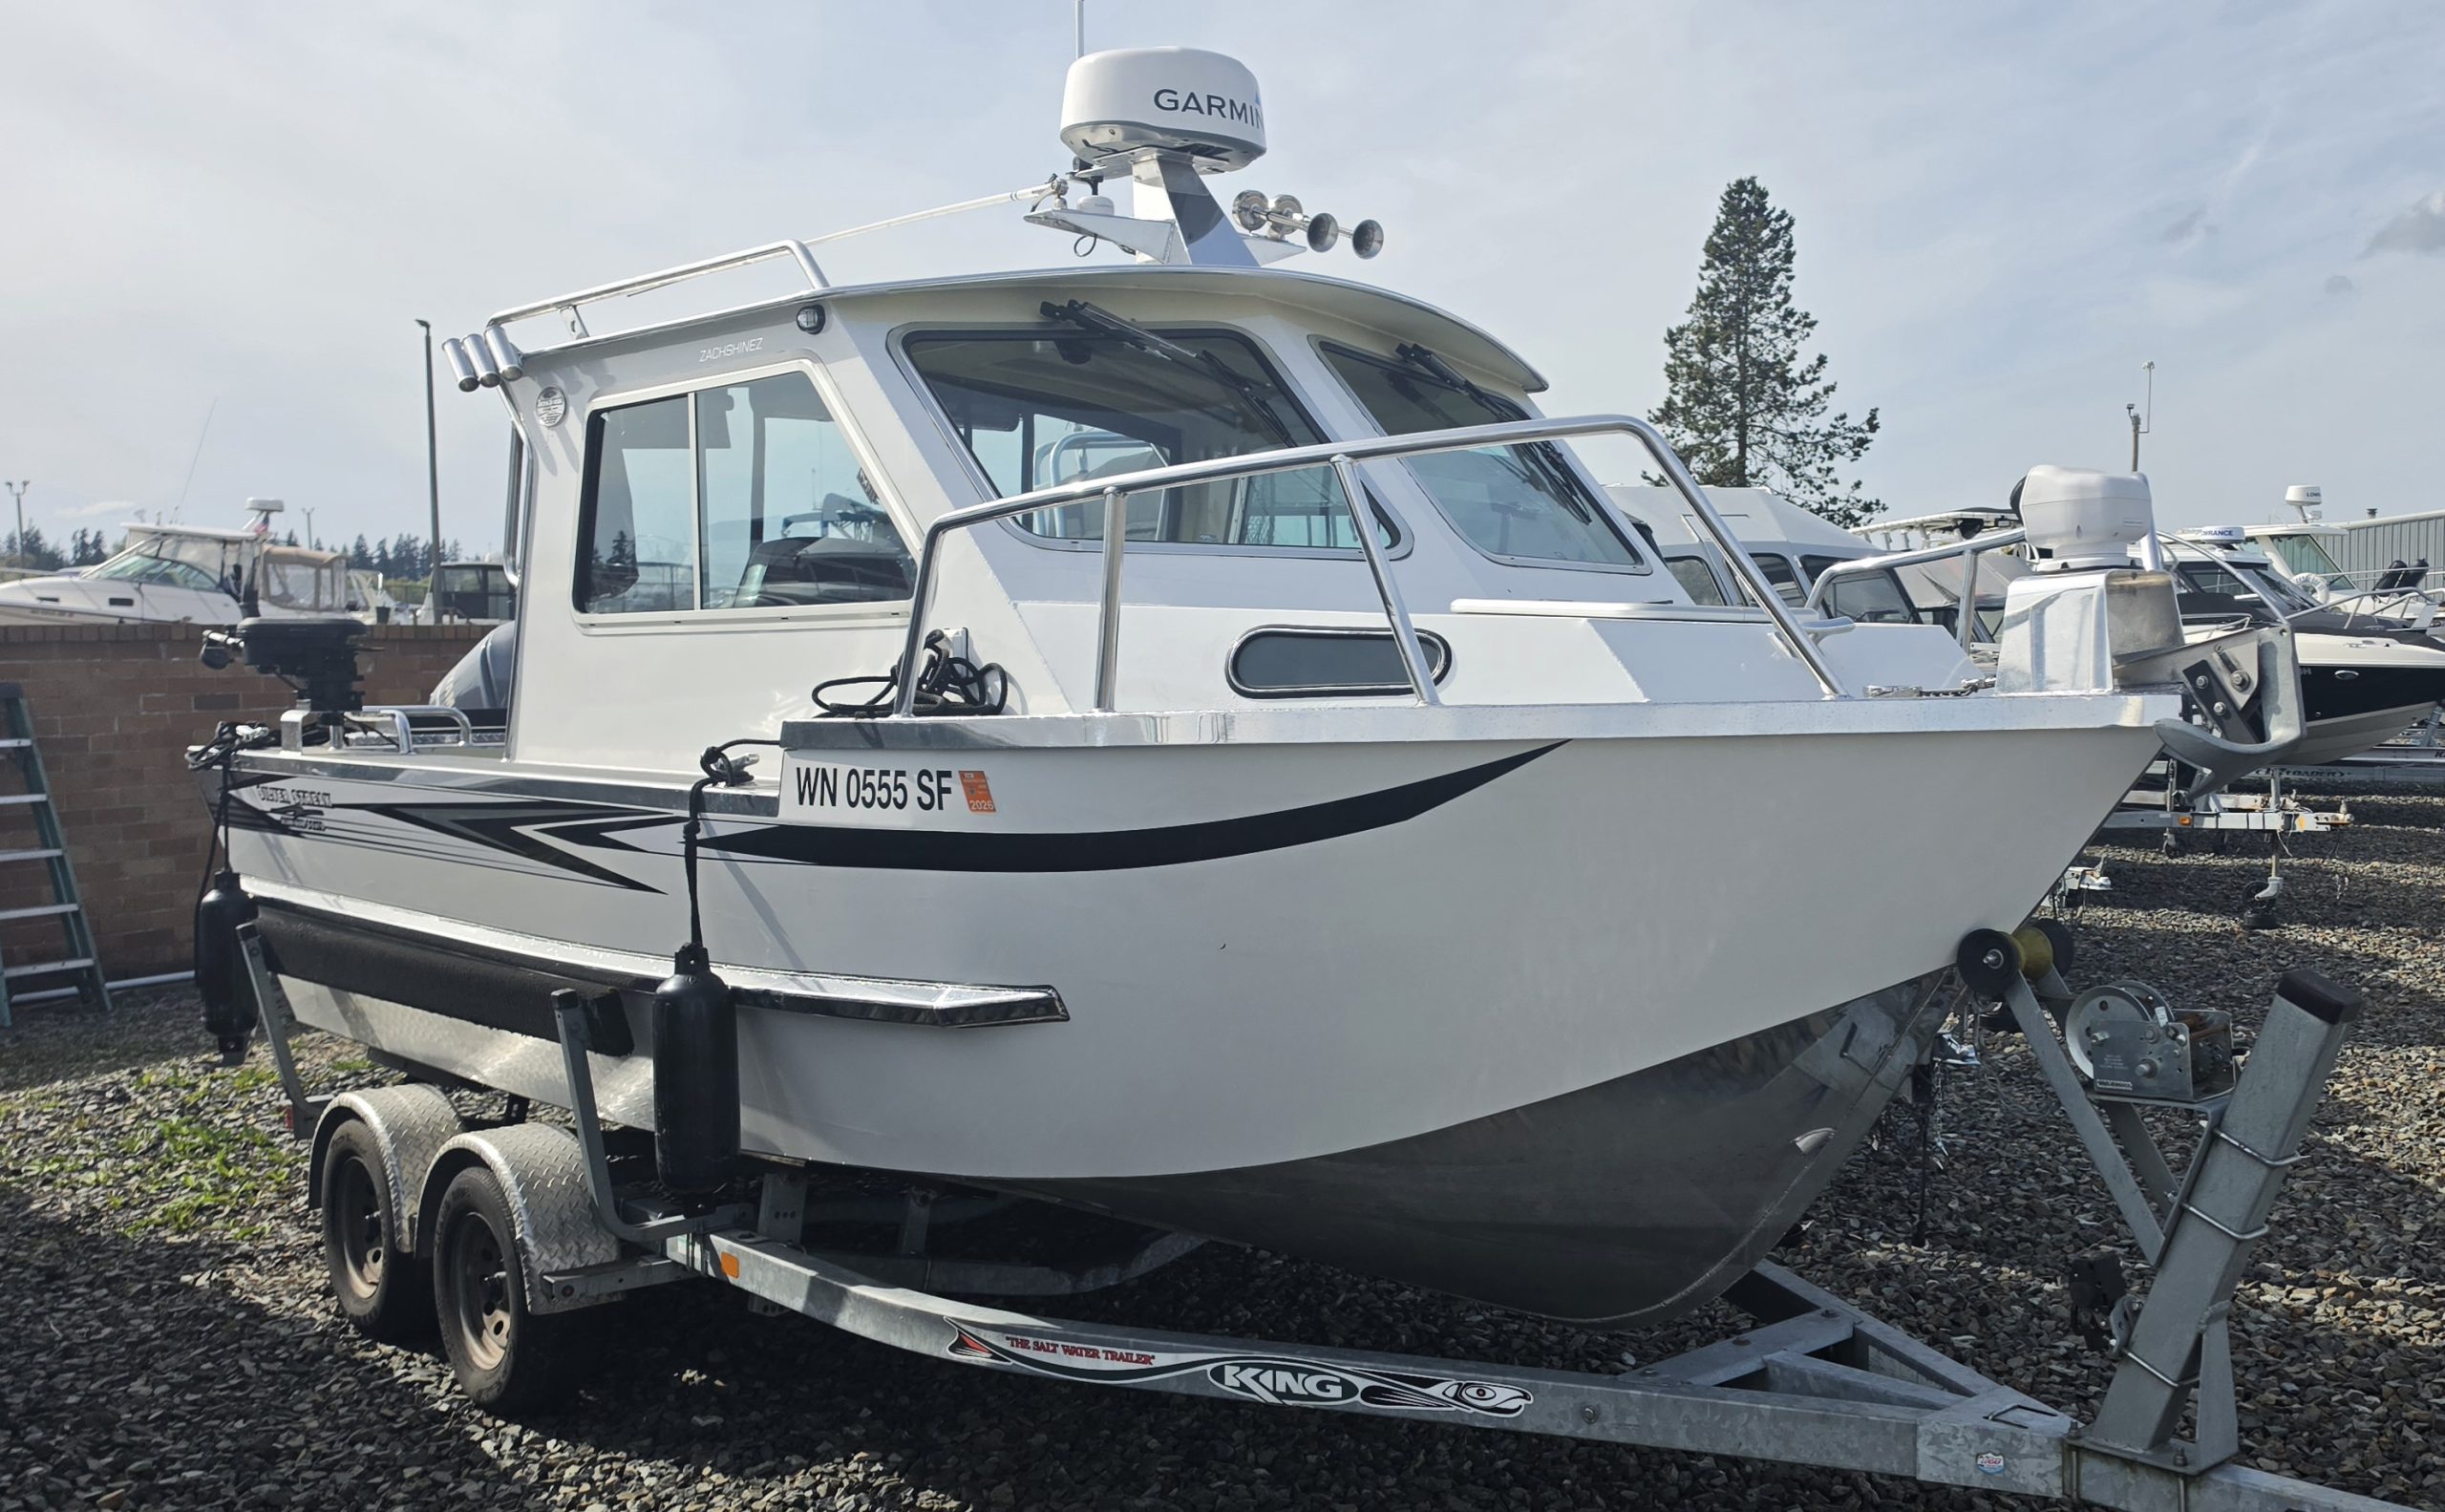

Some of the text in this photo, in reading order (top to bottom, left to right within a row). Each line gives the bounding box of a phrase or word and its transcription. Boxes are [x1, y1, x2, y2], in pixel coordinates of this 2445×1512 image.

[796, 767, 952, 810] WN 0555 SF
[969, 799, 994, 811] 2026
[1032, 1340, 1059, 1353] SALT
[1061, 1344, 1100, 1359] WATER
[1223, 1365, 1343, 1405] KING
